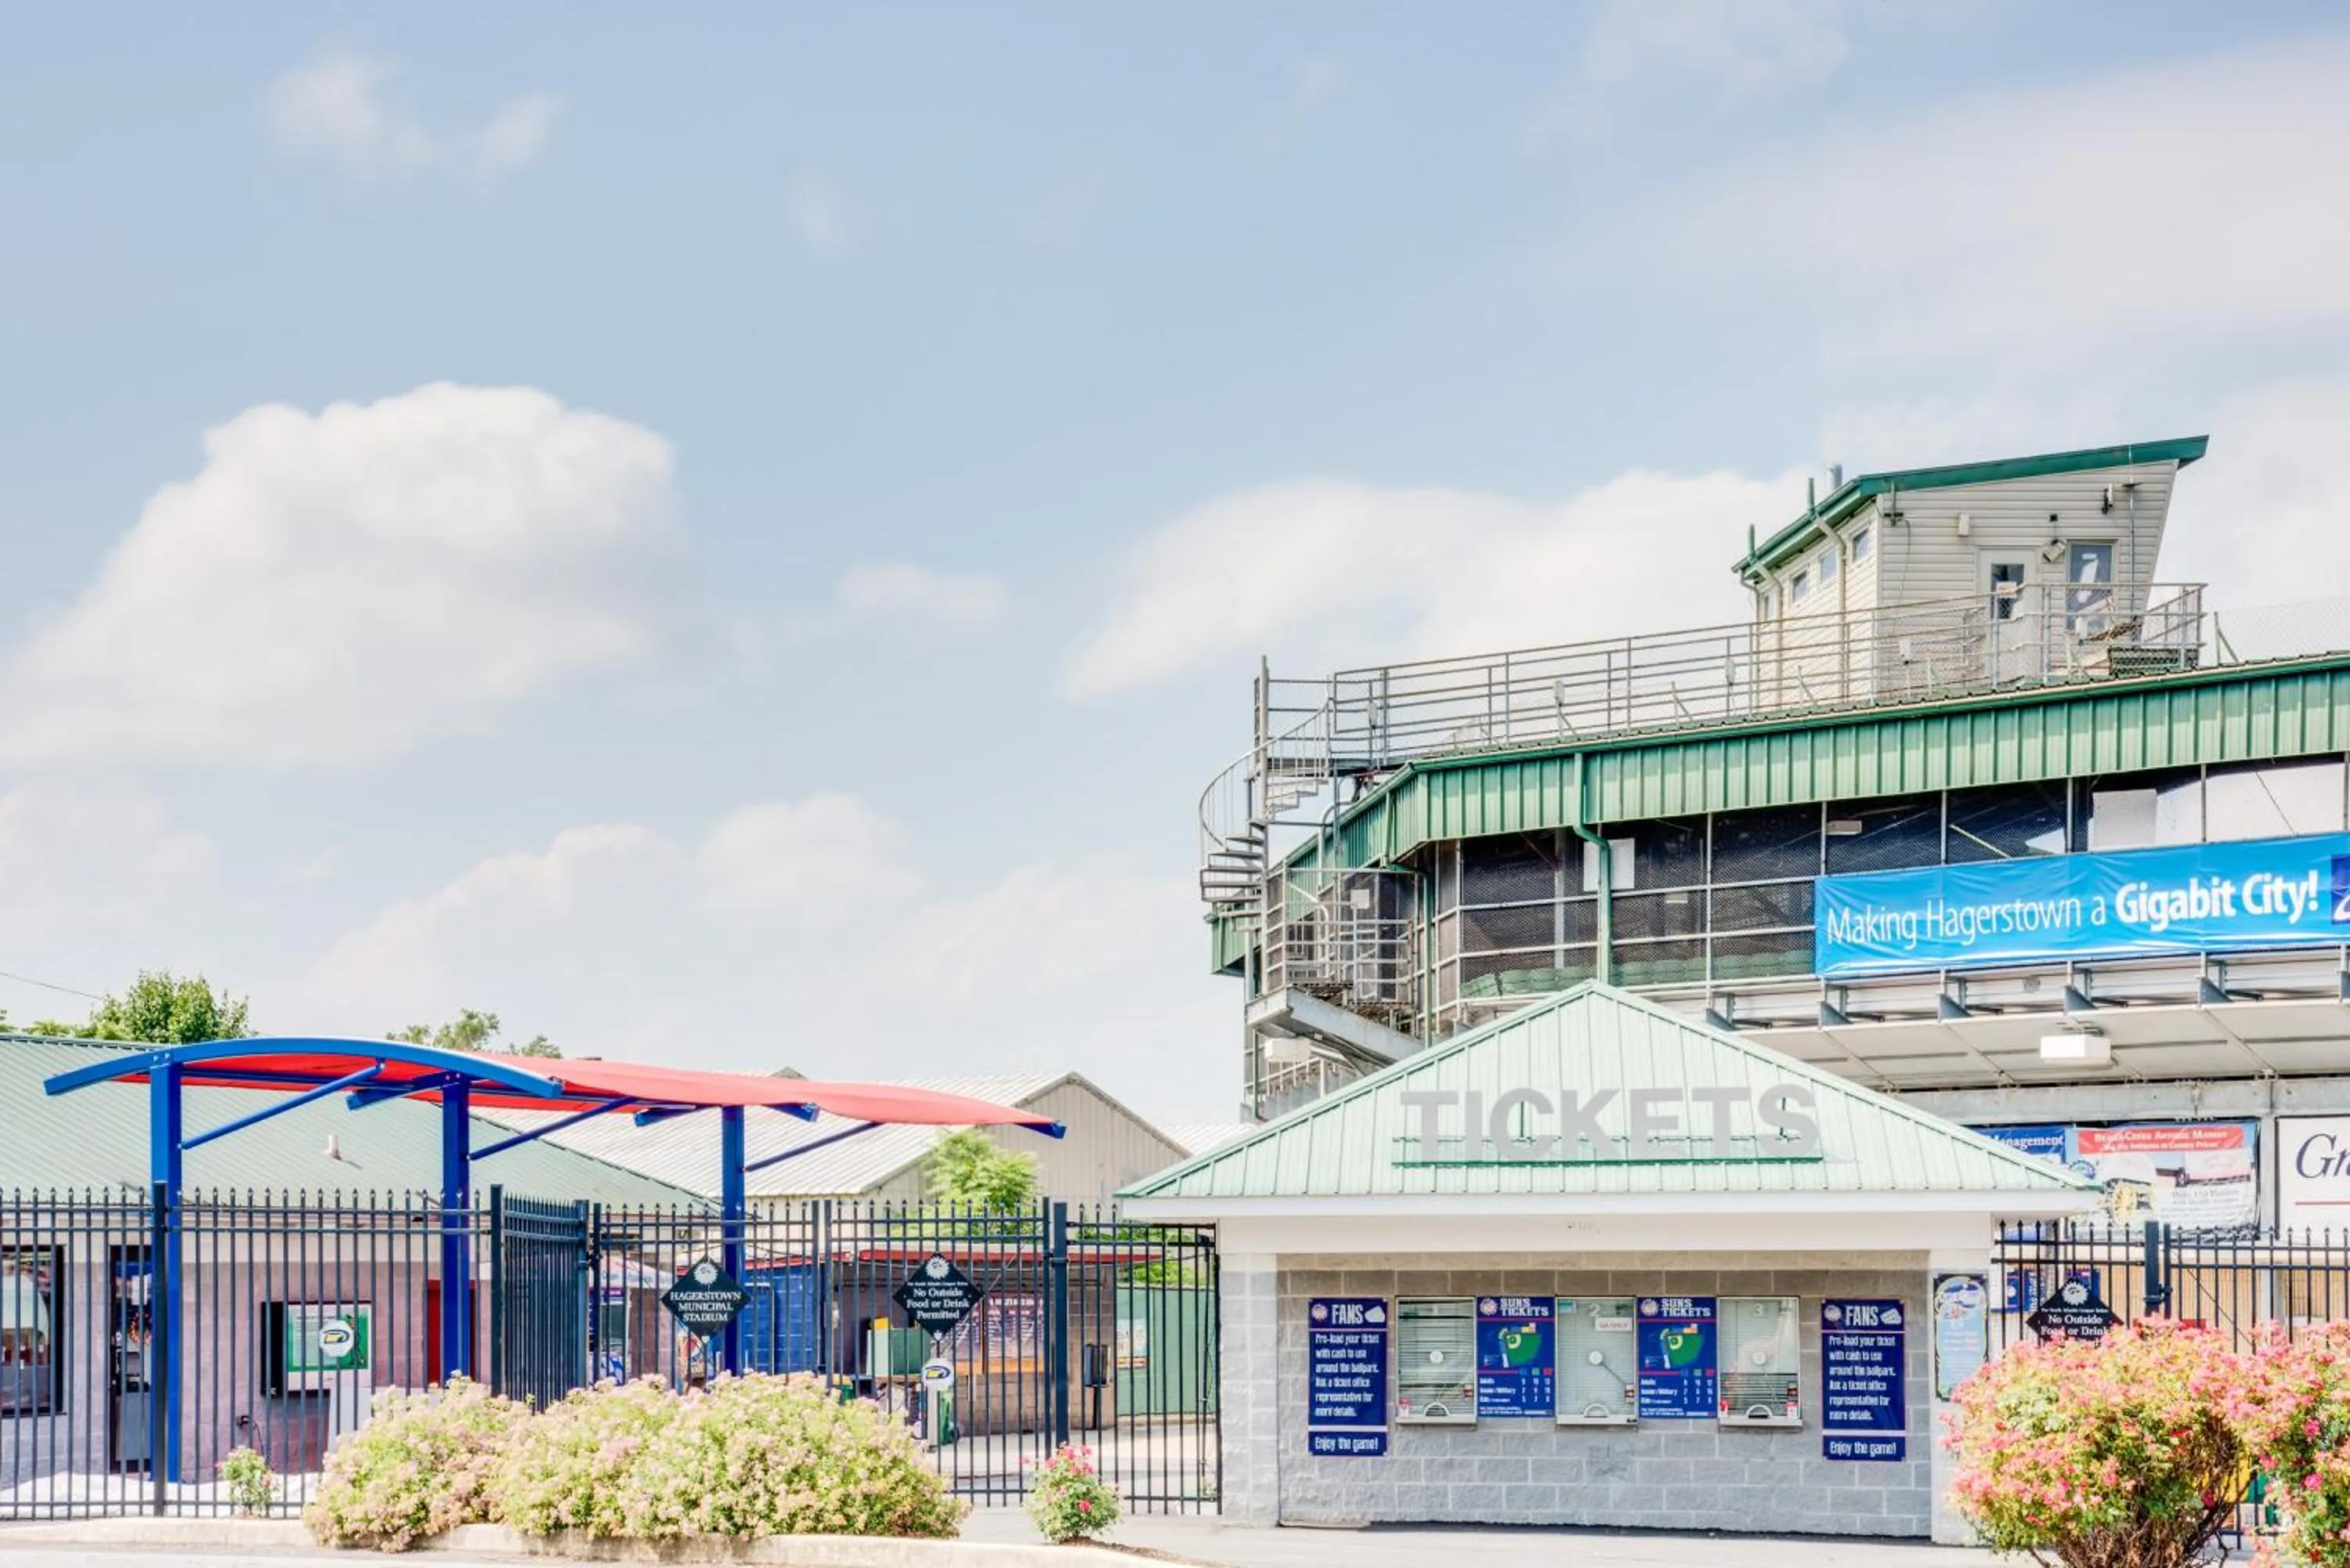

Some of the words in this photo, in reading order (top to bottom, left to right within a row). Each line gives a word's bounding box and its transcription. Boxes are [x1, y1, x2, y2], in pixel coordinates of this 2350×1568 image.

[1828, 904, 1917, 950] Making
[1926, 897, 2081, 945] Hagerstown
[2091, 895, 2106, 926] a
[2116, 876, 2236, 932] Gigabit
[2242, 869, 2319, 924] City!
[1400, 1084, 1820, 1161] TICKETS
[670, 1292, 742, 1300] HAGERSTOWN
[913, 1288, 926, 1298] No
[928, 1288, 964, 1298] Outside
[678, 1302, 733, 1311] MUNICIPAL
[907, 1299, 929, 1309] Food
[943, 1299, 969, 1308] Drink
[1500, 1298, 1531, 1307] SUNS
[1661, 1298, 1692, 1308] SUNS
[916, 1310, 960, 1319] Permitted
[1332, 1304, 1363, 1324] FANS
[1499, 1306, 1549, 1317] TICKETS
[1589, 1303, 1601, 1317] 2
[1661, 1307, 1712, 1317] TICKETS
[1754, 1303, 1763, 1317] 3
[683, 1313, 728, 1321] STADIUM
[1845, 1305, 1879, 1326] FANS
[2048, 1314, 2062, 1324] No
[2065, 1314, 2103, 1324] Outside
[1315, 1436, 1336, 1451] Enjoy
[1338, 1436, 1350, 1449] the
[1353, 1437, 1379, 1452] game!
[1829, 1441, 1852, 1456] Enjoy
[1854, 1441, 1867, 1454] the
[1870, 1443, 1896, 1457] game!
